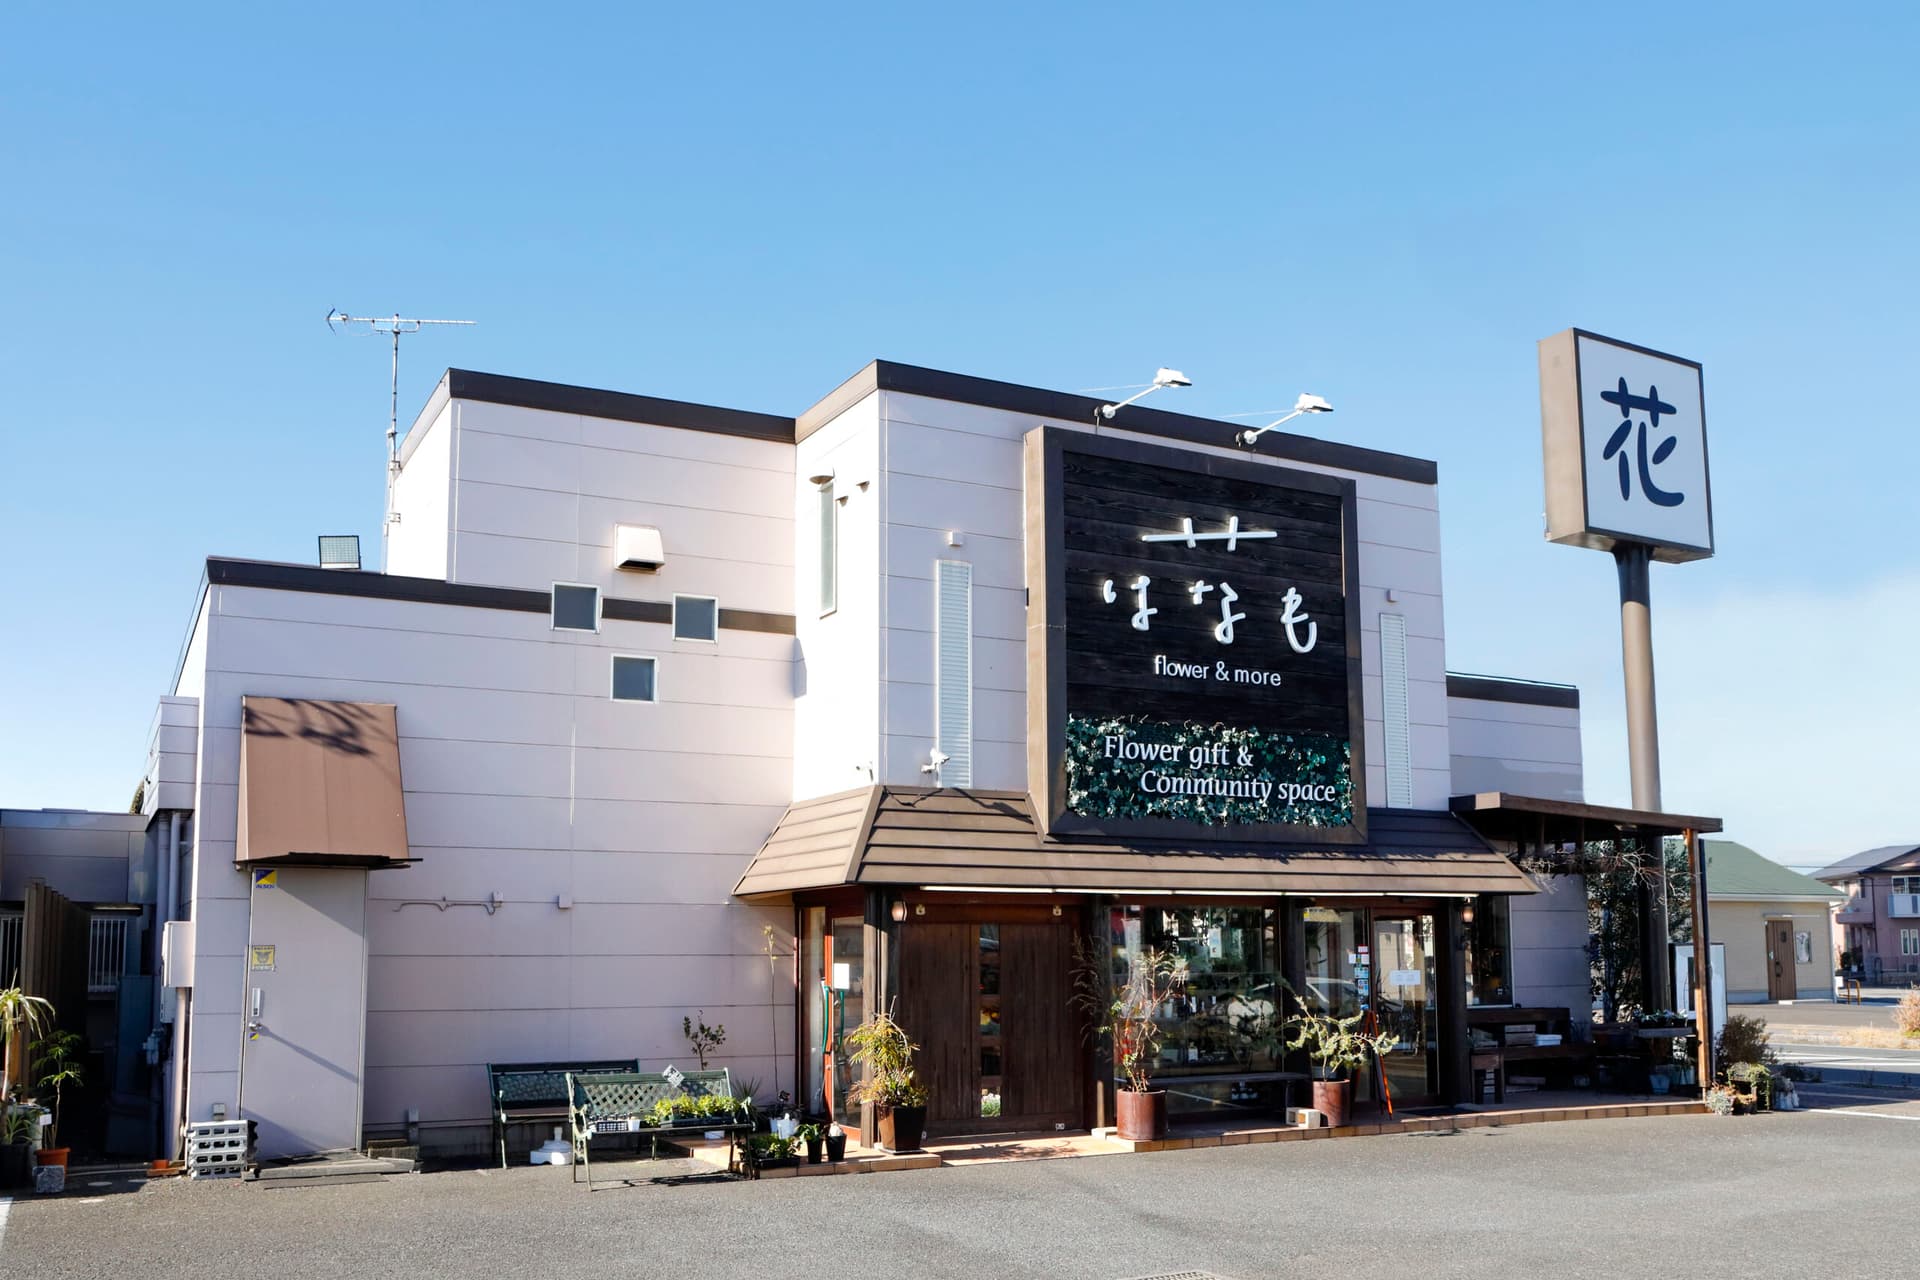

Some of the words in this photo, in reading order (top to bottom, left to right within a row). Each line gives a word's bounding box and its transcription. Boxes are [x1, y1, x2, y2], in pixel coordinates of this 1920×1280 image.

[1600, 376, 1685, 507] 花
[1103, 575, 1317, 653] はなも
[1154, 655, 1209, 679] flower
[1215, 661, 1229, 682] &
[1234, 668, 1281, 686] more
[1104, 735, 1183, 760] Flower
[1189, 741, 1230, 769] gift
[1237, 745, 1253, 766] &
[1140, 770, 1272, 800] Community
[1277, 782, 1336, 805] space
